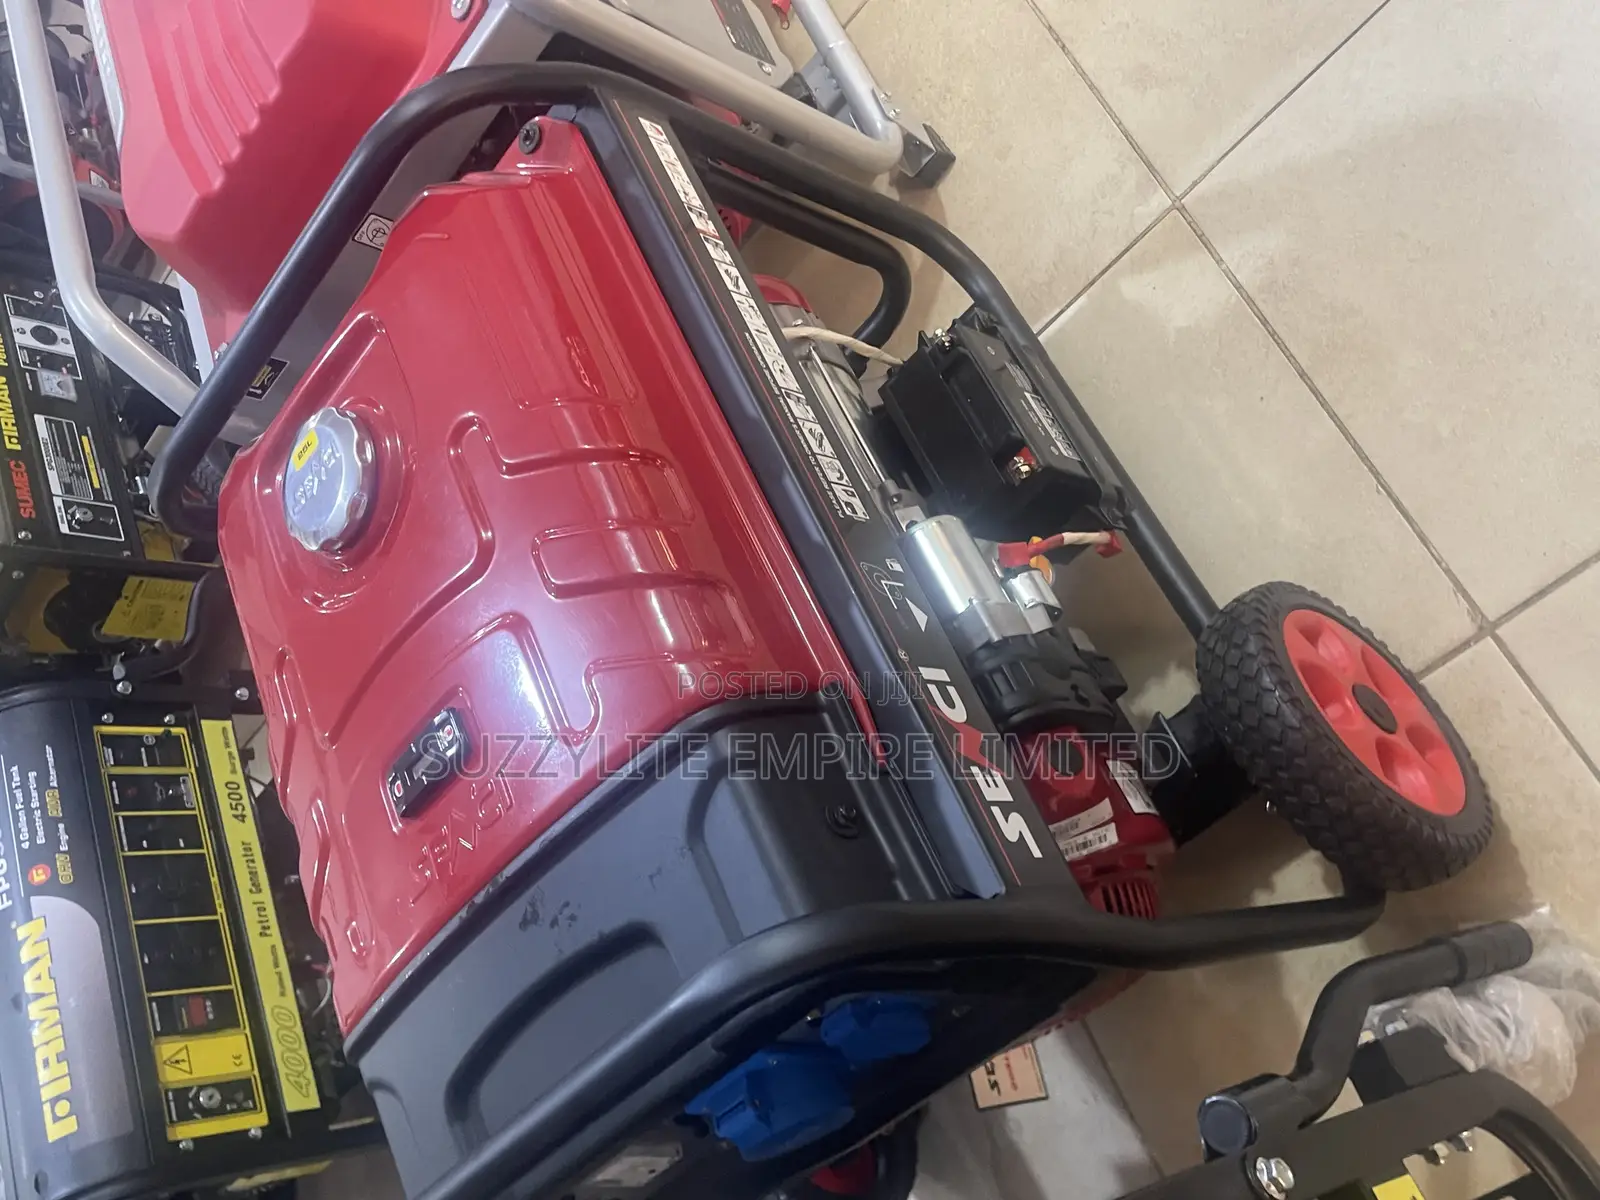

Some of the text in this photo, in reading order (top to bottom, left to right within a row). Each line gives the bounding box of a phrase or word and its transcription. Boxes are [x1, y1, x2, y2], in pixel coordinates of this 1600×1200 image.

[809, 455, 816, 465] TO
[10, 459, 36, 519] SUMEC
[10, 765, 30, 850] 4 Gallon Fuel Tank
[28, 771, 46, 844] Electric Starting
[225, 781, 246, 824] 4500
[58, 823, 69, 851] Engine
[241, 841, 262, 894] Generator
[253, 901, 272, 938] Petrol
[16, 916, 78, 1143] FIRMAN
[271, 1004, 311, 1098] 4000
